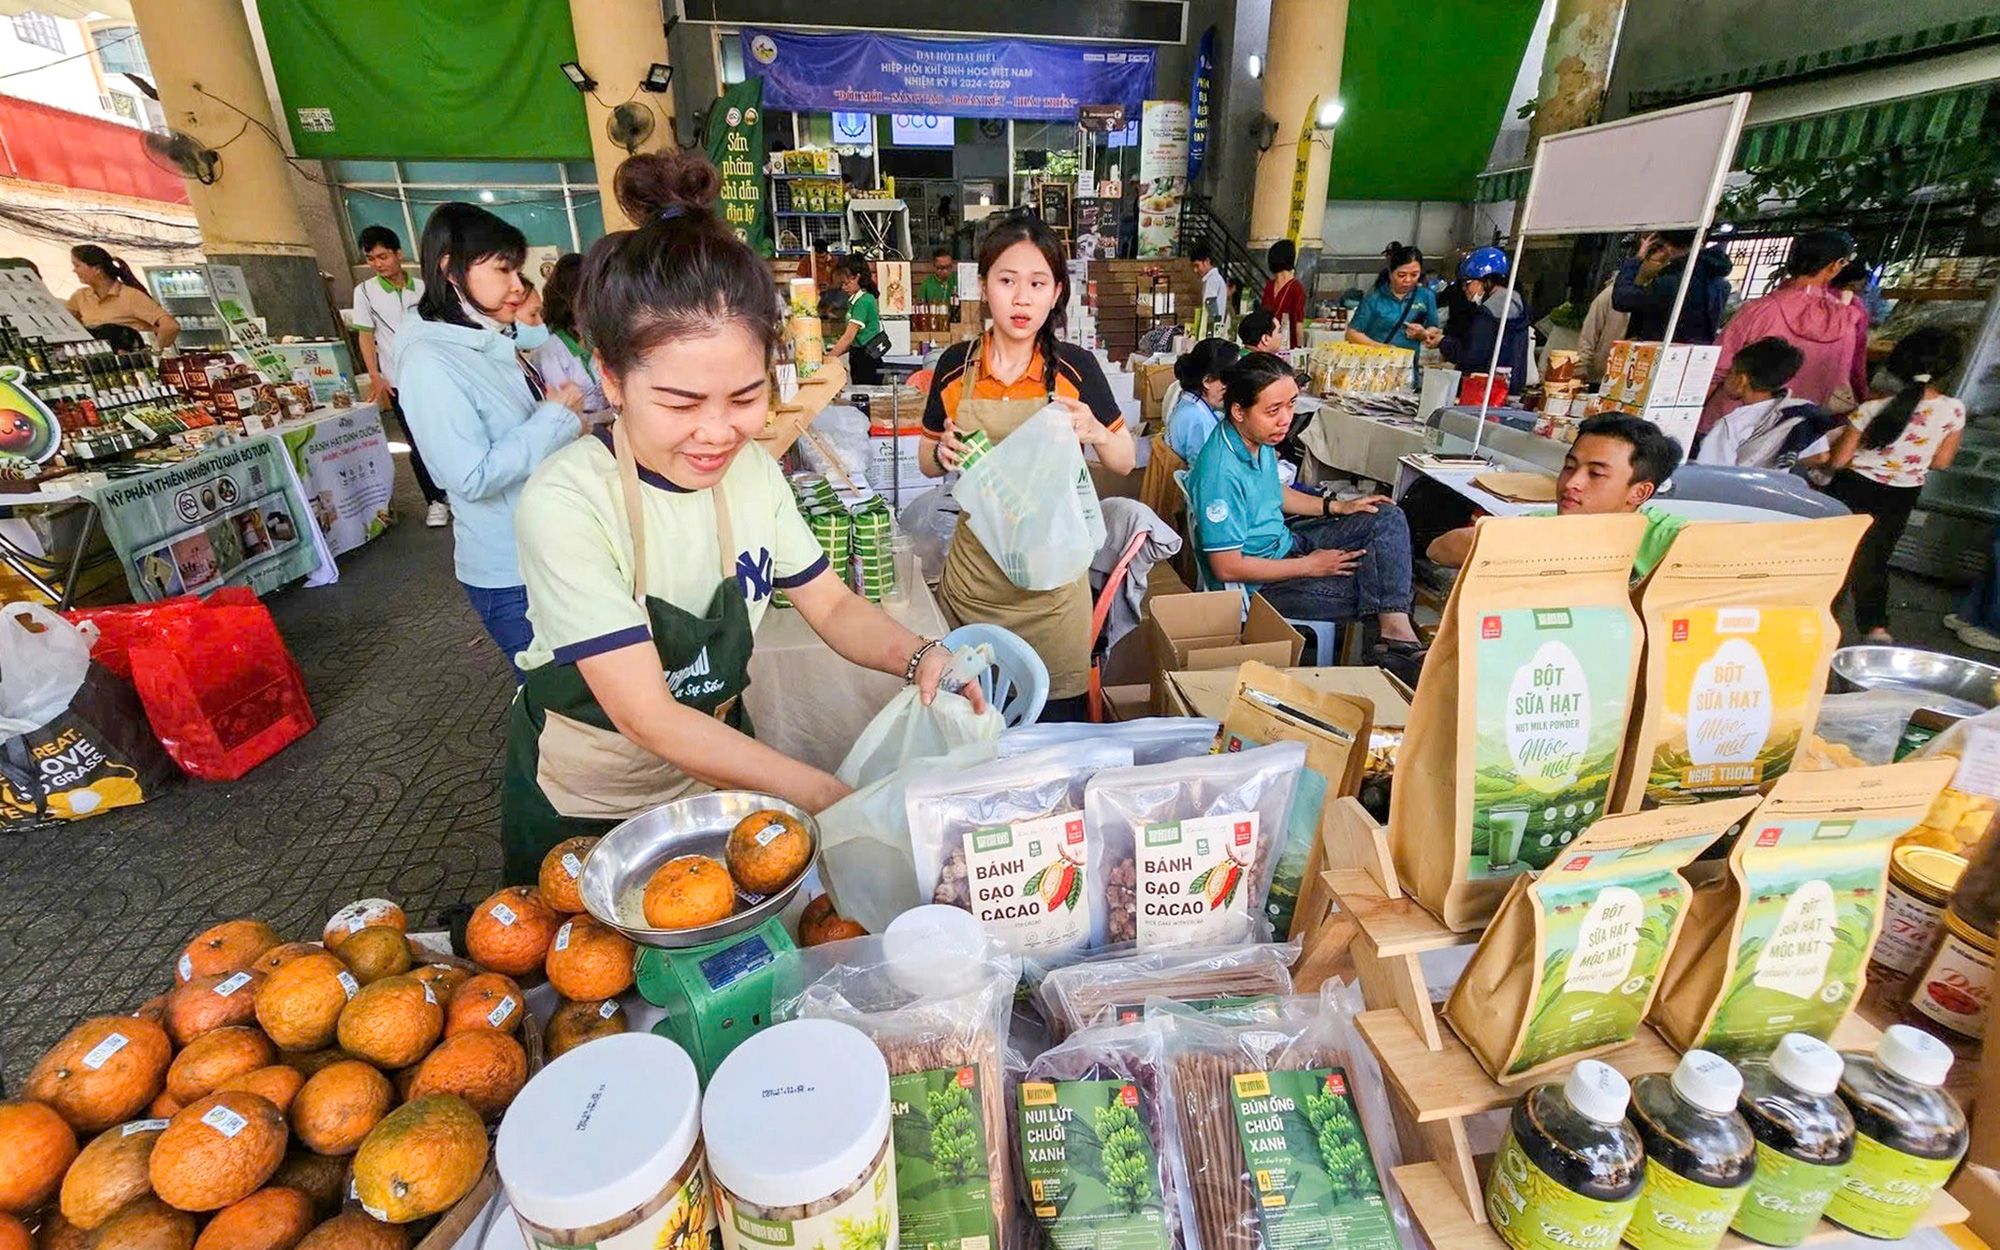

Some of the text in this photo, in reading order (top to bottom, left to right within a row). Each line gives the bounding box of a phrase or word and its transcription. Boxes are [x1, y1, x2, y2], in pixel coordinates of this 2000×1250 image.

[881, 62, 902, 76] HIỆP
[904, 62, 922, 76] HỘI
[943, 65, 965, 75] SINH
[967, 66, 989, 77] HỌC
[991, 65, 1010, 78] VIỆT
[1011, 68, 1033, 77] NAM
[960, 78, 981, 88] 2024
[989, 79, 1011, 89] 2029
[106, 490, 126, 508] MỸ
[155, 472, 186, 492] THIÊN
[1533, 663, 1565, 691] BỘT
[1714, 661, 1745, 687] BỘT
[1515, 692, 1582, 716] SỮA HẠT
[1696, 688, 1761, 712] SỮA HẠT
[1516, 719, 1580, 733] NUT MILK POWDER
[51, 752, 107, 786] GRASS.
[1688, 765, 1716, 784] NGHỆ
[976, 859, 1025, 880] BÁNH
[1145, 856, 1192, 874] BÁNH
[979, 884, 1014, 903] GẠO
[1145, 881, 1180, 899] GẠO
[981, 902, 1041, 921] CACAO
[1145, 901, 1204, 916] CACAO
[1601, 903, 1626, 922] BỘT
[1588, 921, 1631, 948] SỮA HẠT
[1579, 943, 1628, 969] MỘC MÁT
[1769, 939, 1821, 961] MỘC MÁT
[1025, 1105, 1073, 1125] NUI LỨT
[1240, 1095, 1295, 1116] BÚN ỐNG
[1245, 1114, 1285, 1134] CHUỐI
[1027, 1124, 1066, 1144] CHUỐI
[1249, 1136, 1287, 1153] XANH
[1028, 1146, 1066, 1163] XANH
[1260, 1173, 1269, 1189] 4
[1034, 1183, 1042, 1199] 4
